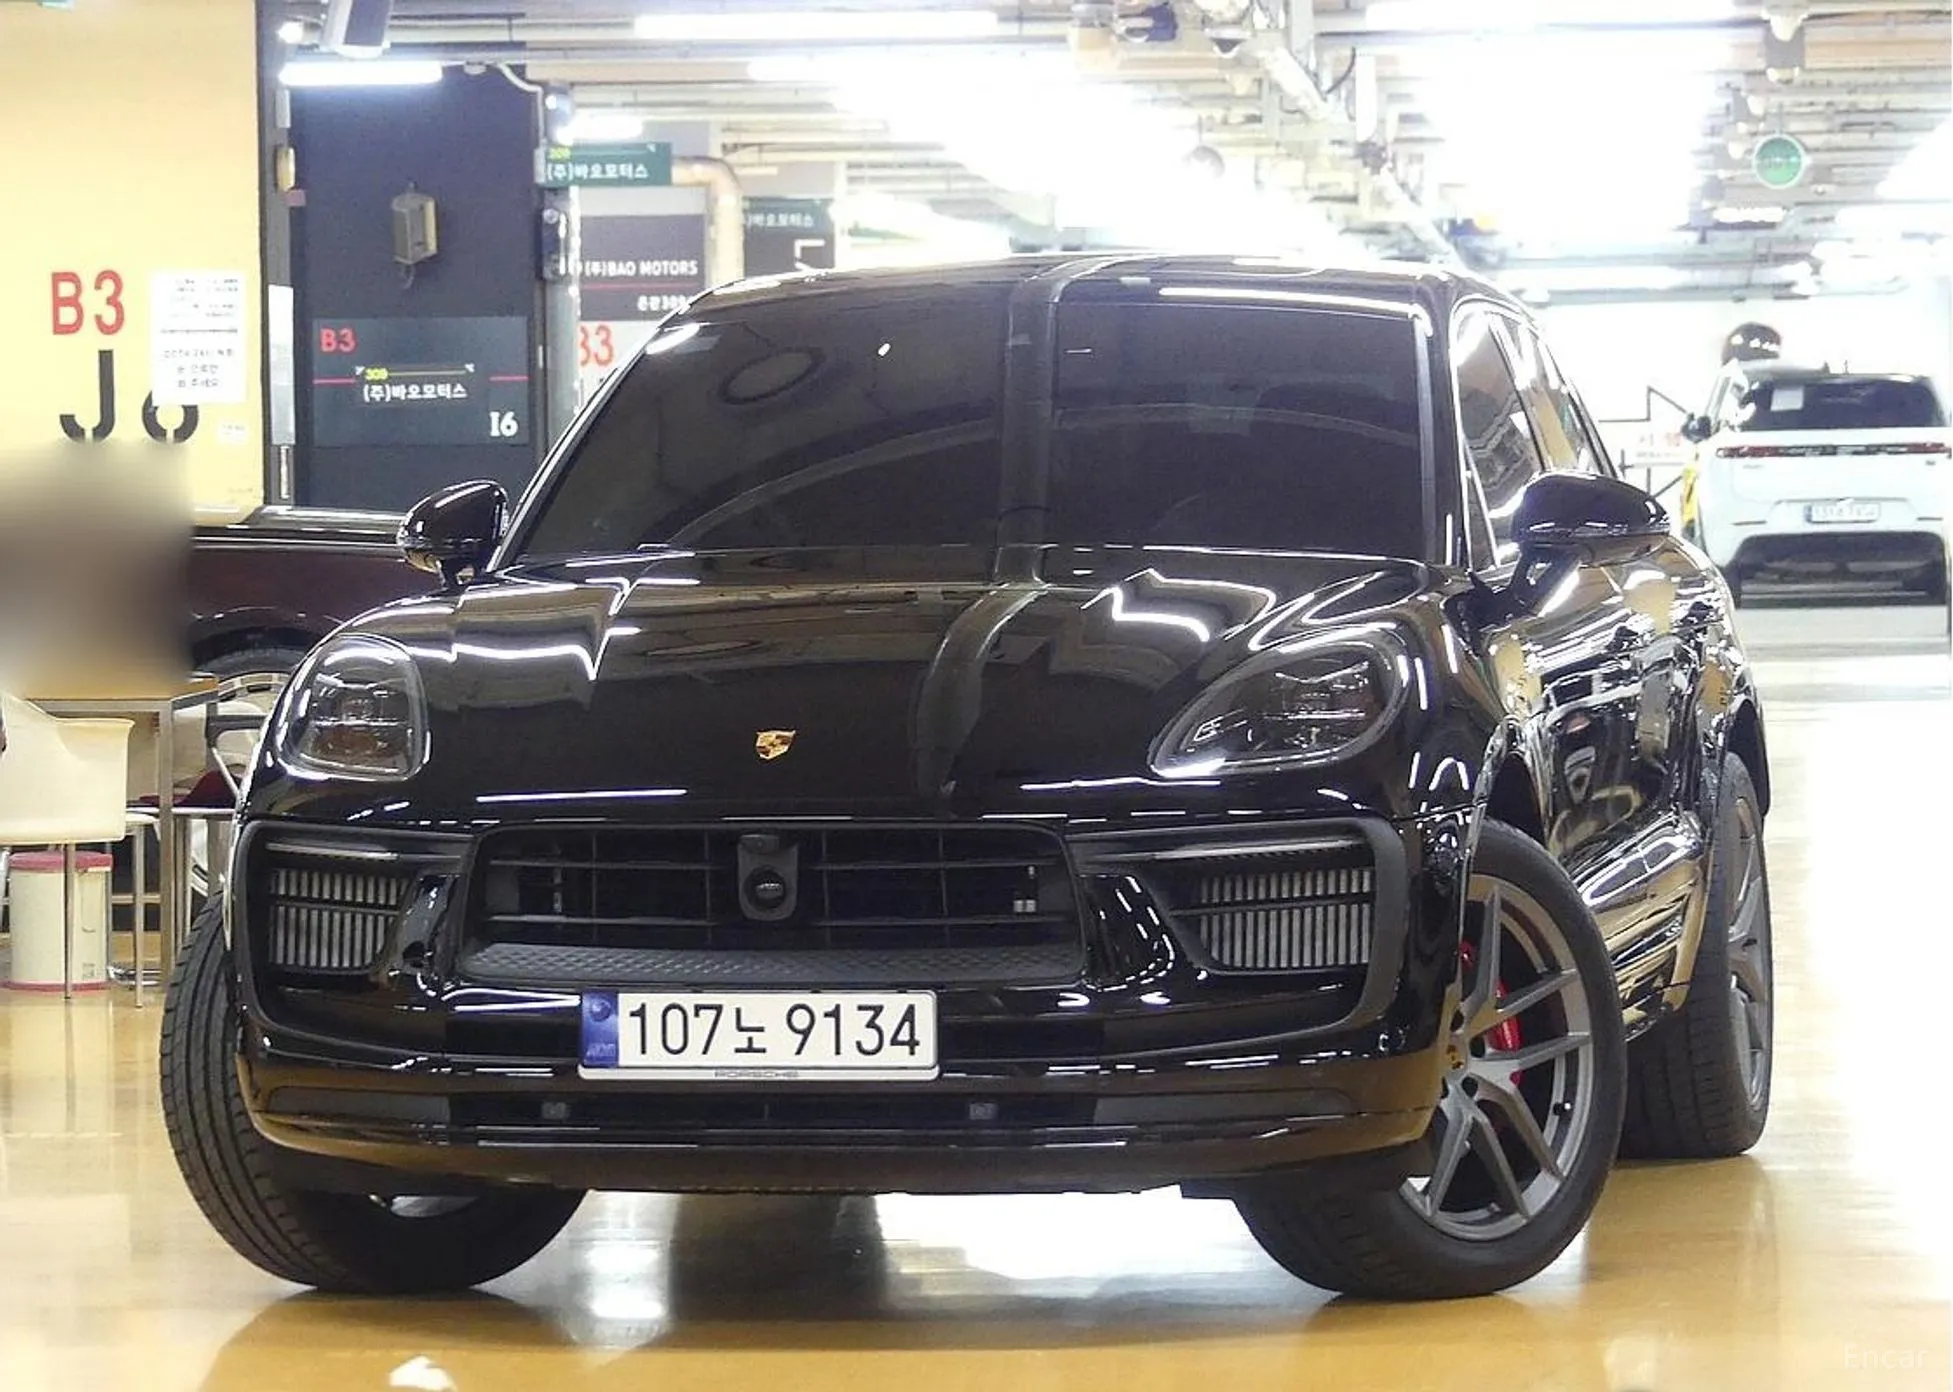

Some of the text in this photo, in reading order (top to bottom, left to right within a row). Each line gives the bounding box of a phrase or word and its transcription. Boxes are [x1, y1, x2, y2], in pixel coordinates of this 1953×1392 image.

[547, 163, 650, 181] (주)바오모터스
[640, 260, 699, 276] MOTORS
[51, 270, 125, 335] B3
[320, 328, 357, 352] B3
[363, 383, 468, 402] (주)바오모터스
[629, 1002, 920, 1056] 107노 9134
